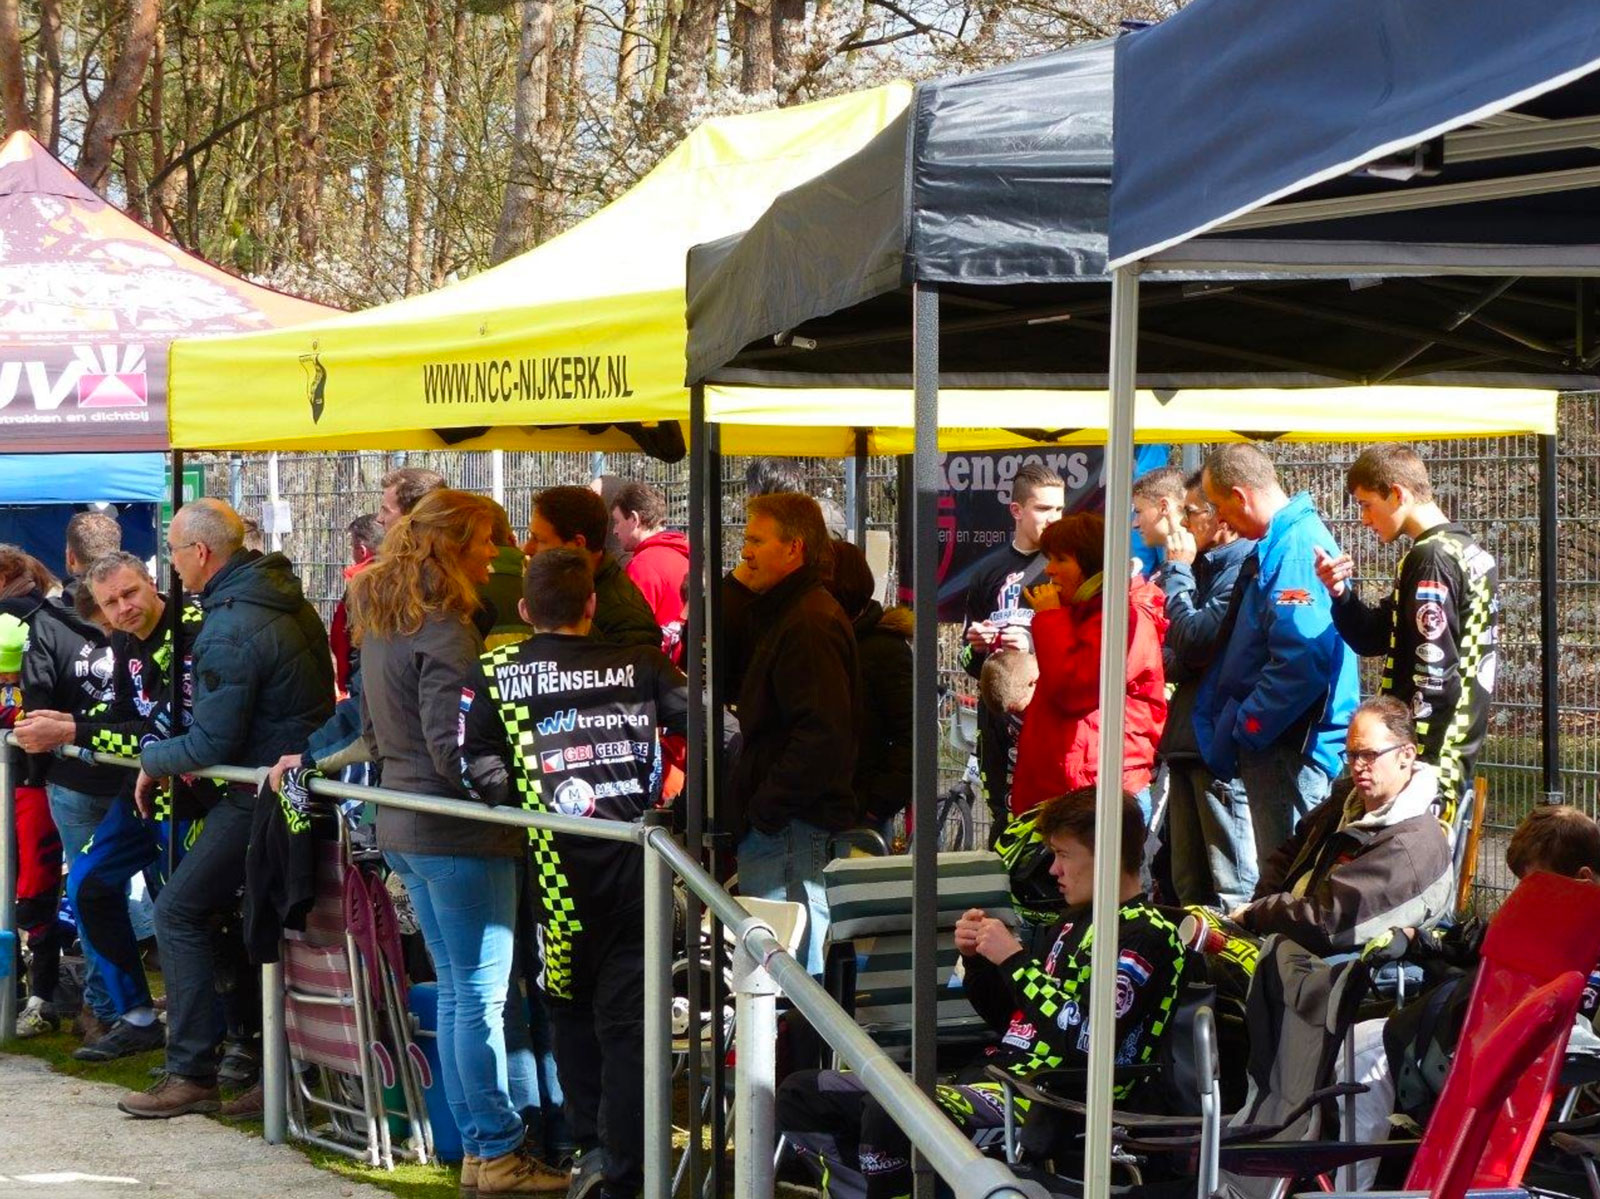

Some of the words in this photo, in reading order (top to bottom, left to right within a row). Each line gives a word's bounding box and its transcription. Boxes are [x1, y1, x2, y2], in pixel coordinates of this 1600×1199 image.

[423, 355, 634, 404] WWW.NCC-NIJKERK.NL
[66, 413, 87, 423] en
[90, 411, 149, 422] dichtbij
[956, 530, 969, 543] en
[973, 530, 1006, 547] zagen
[496, 661, 558, 679] WOUTER
[498, 675, 533, 702] VAN
[537, 664, 635, 695] RENSELAAR
[577, 713, 650, 730] trappen
